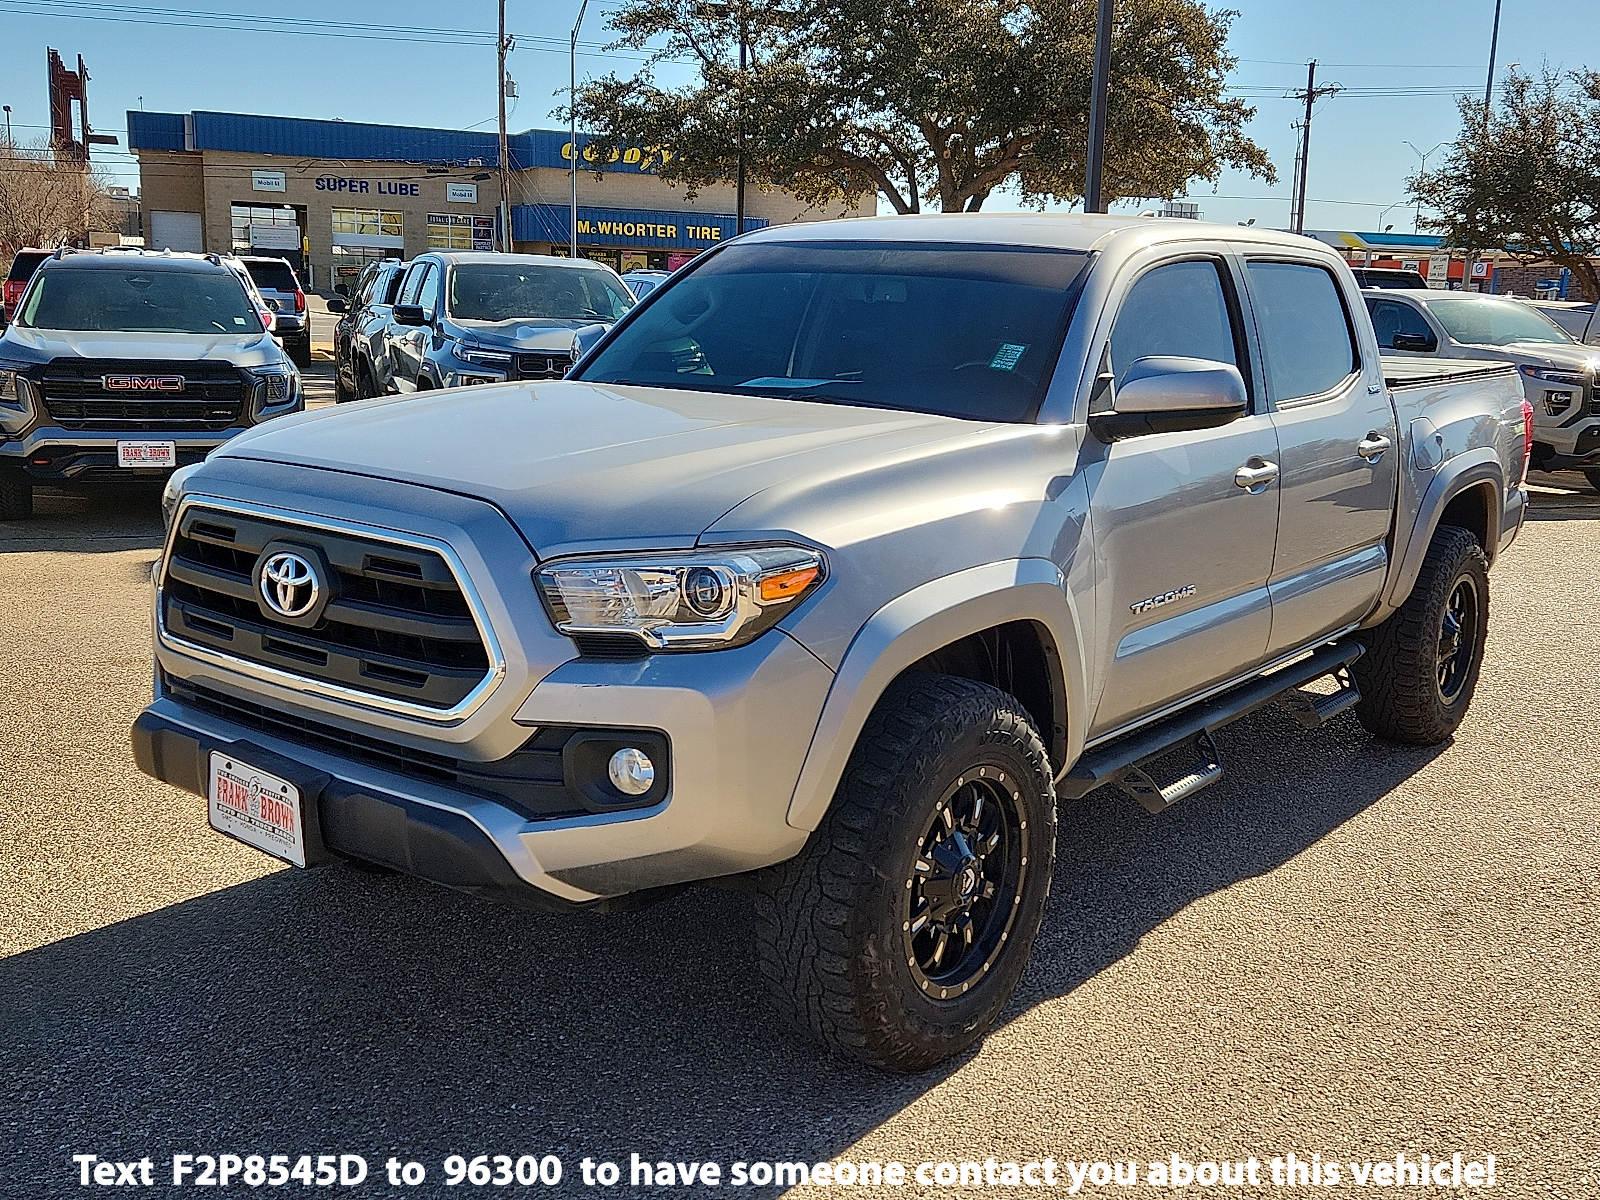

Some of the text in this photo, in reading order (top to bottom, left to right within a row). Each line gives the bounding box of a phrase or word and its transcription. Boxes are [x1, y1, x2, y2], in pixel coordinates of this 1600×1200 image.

[315, 178, 419, 196] SUPER LUBE
[577, 220, 721, 240] McWHORTER TIRE
[108, 376, 179, 389] GMC
[1129, 584, 1197, 615] TACOMA
[217, 776, 295, 834] FRANK BROWN
